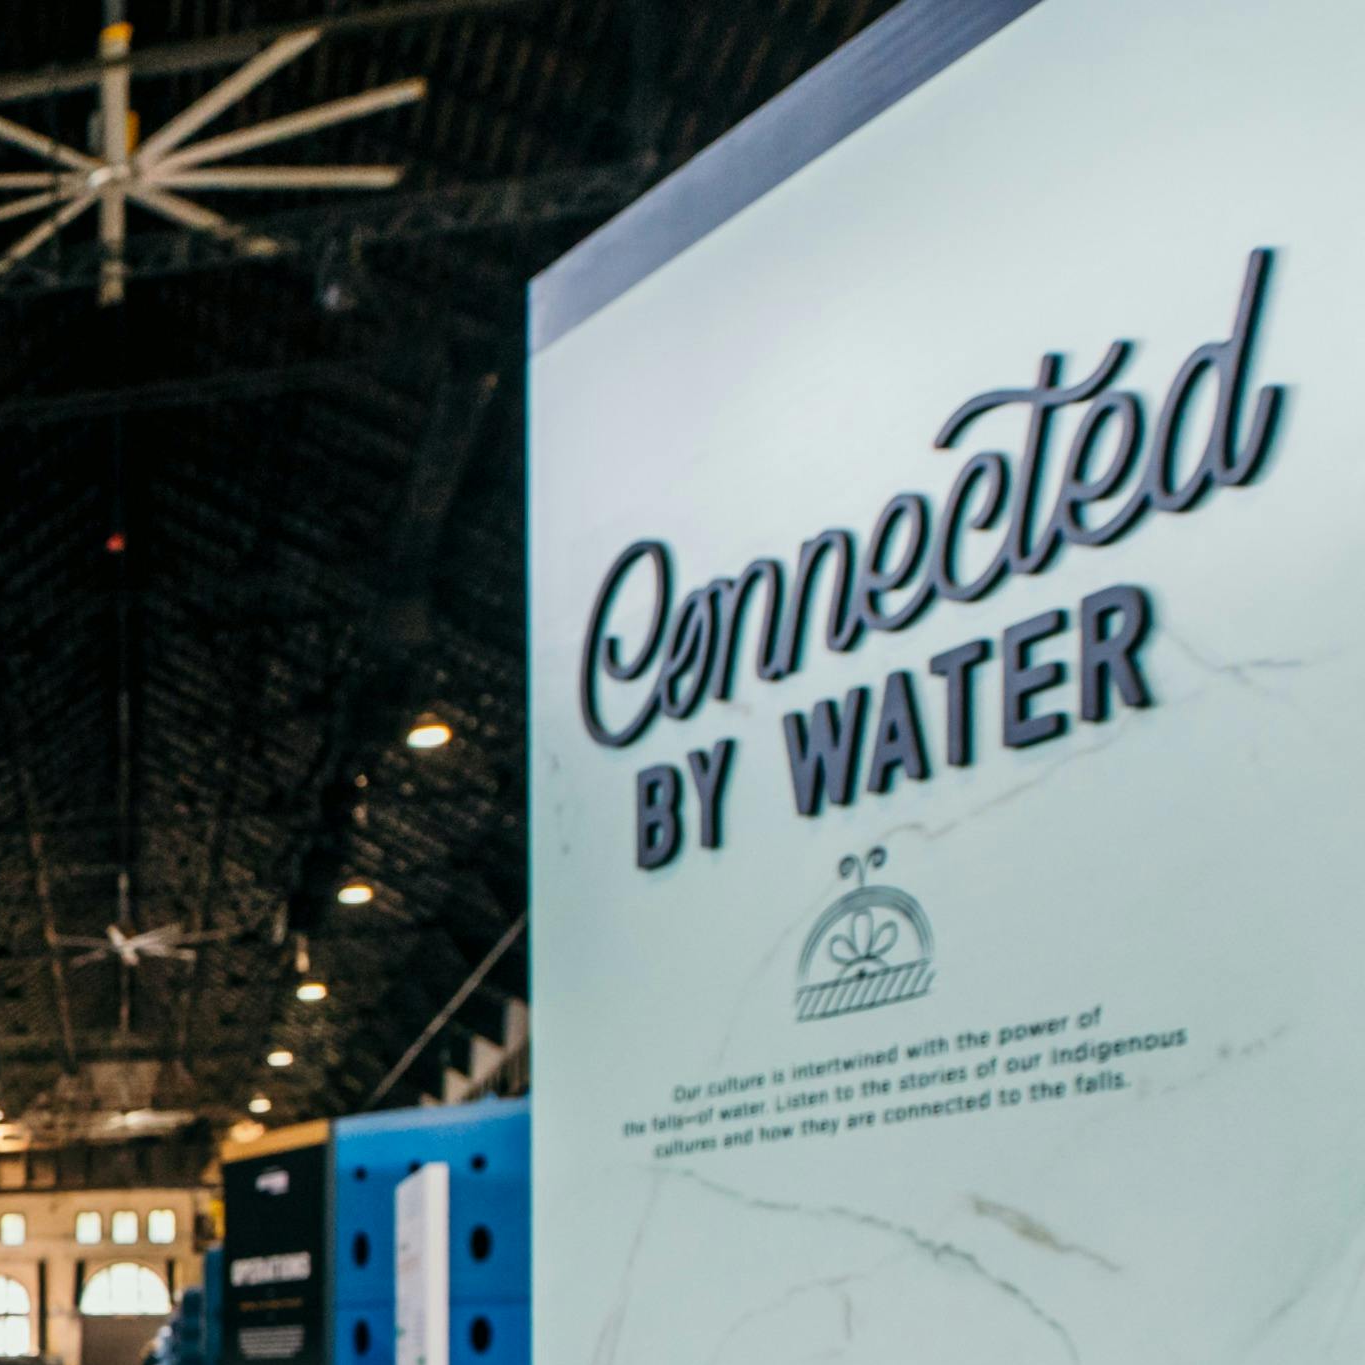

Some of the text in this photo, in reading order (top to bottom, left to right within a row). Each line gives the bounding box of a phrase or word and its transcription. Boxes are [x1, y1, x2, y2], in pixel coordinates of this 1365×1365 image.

[580, 246, 1292, 748] Connected
[637, 583, 1159, 871] BY WATER
[623, 1120, 647, 1137] the
[775, 1087, 830, 1113] Listen
[835, 1084, 854, 1103] to
[861, 1077, 892, 1097] the
[898, 1063, 968, 1093] stories
[976, 1055, 998, 1080] of
[1005, 1051, 1042, 1074] our
[1051, 1028, 1187, 1063] Indigenous
[674, 1003, 1103, 1104] Our culture is intertwined with the power of
[654, 1070, 1131, 1160] cultures and how they are connected to the falls.
